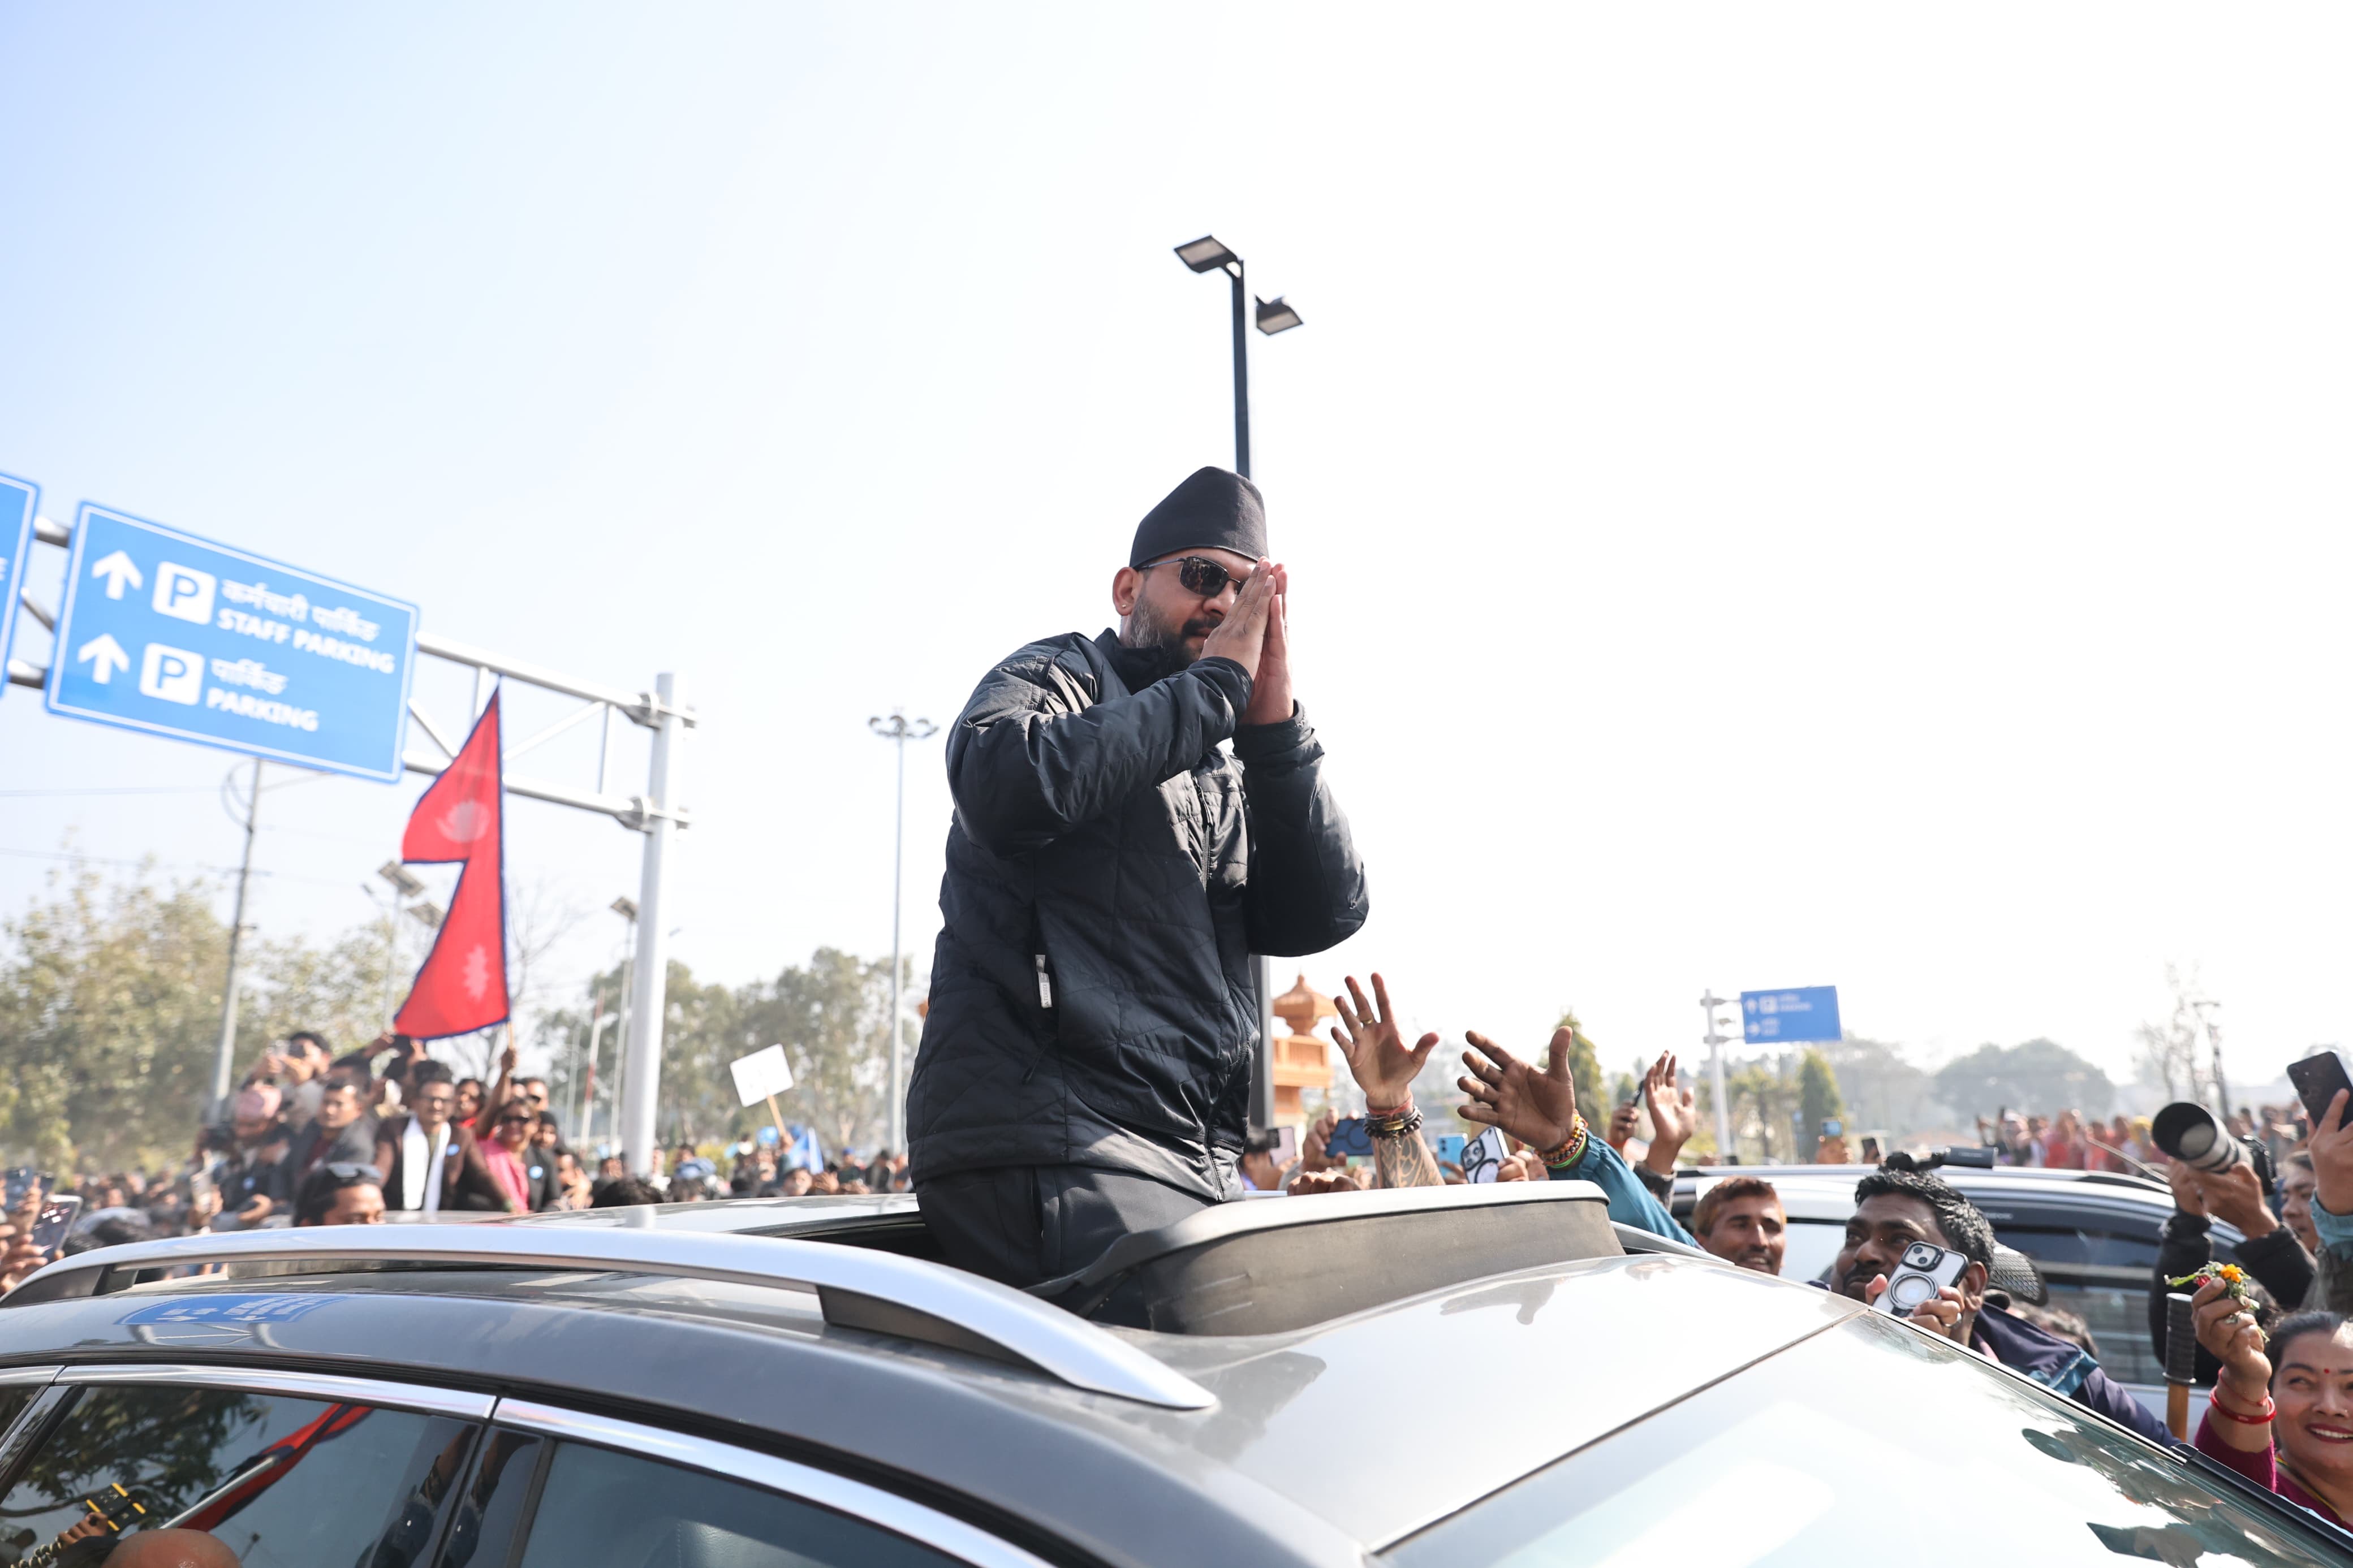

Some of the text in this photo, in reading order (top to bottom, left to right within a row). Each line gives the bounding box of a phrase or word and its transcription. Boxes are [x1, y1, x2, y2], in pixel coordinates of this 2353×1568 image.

[217, 607, 395, 674] STAFF PARKING
[207, 686, 318, 732] PARKING
